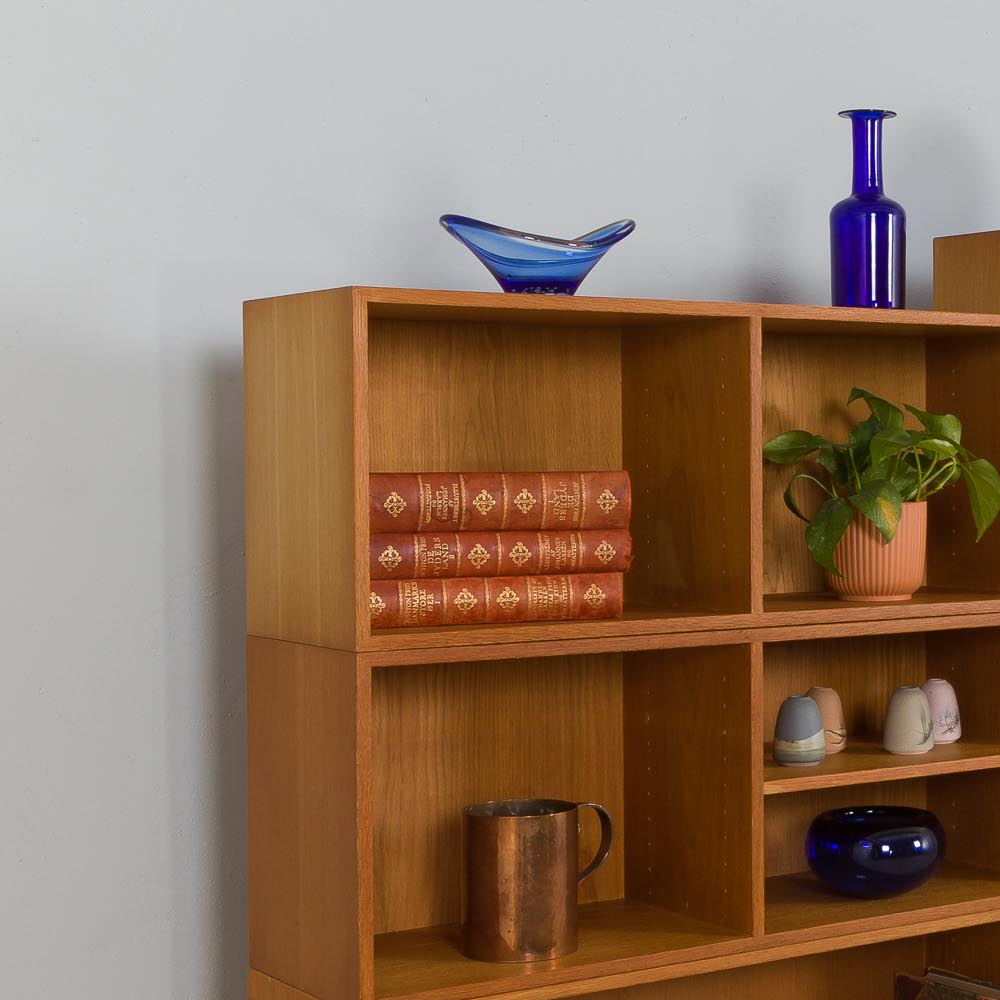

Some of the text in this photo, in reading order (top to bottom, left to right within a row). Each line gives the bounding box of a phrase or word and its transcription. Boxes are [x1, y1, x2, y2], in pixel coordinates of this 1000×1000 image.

[559, 481, 567, 521] JYDERS
[427, 550, 434, 564] DE
[433, 537, 441, 577] JYDERS
[441, 543, 449, 570] LAND
[419, 589, 427, 617] STORE
